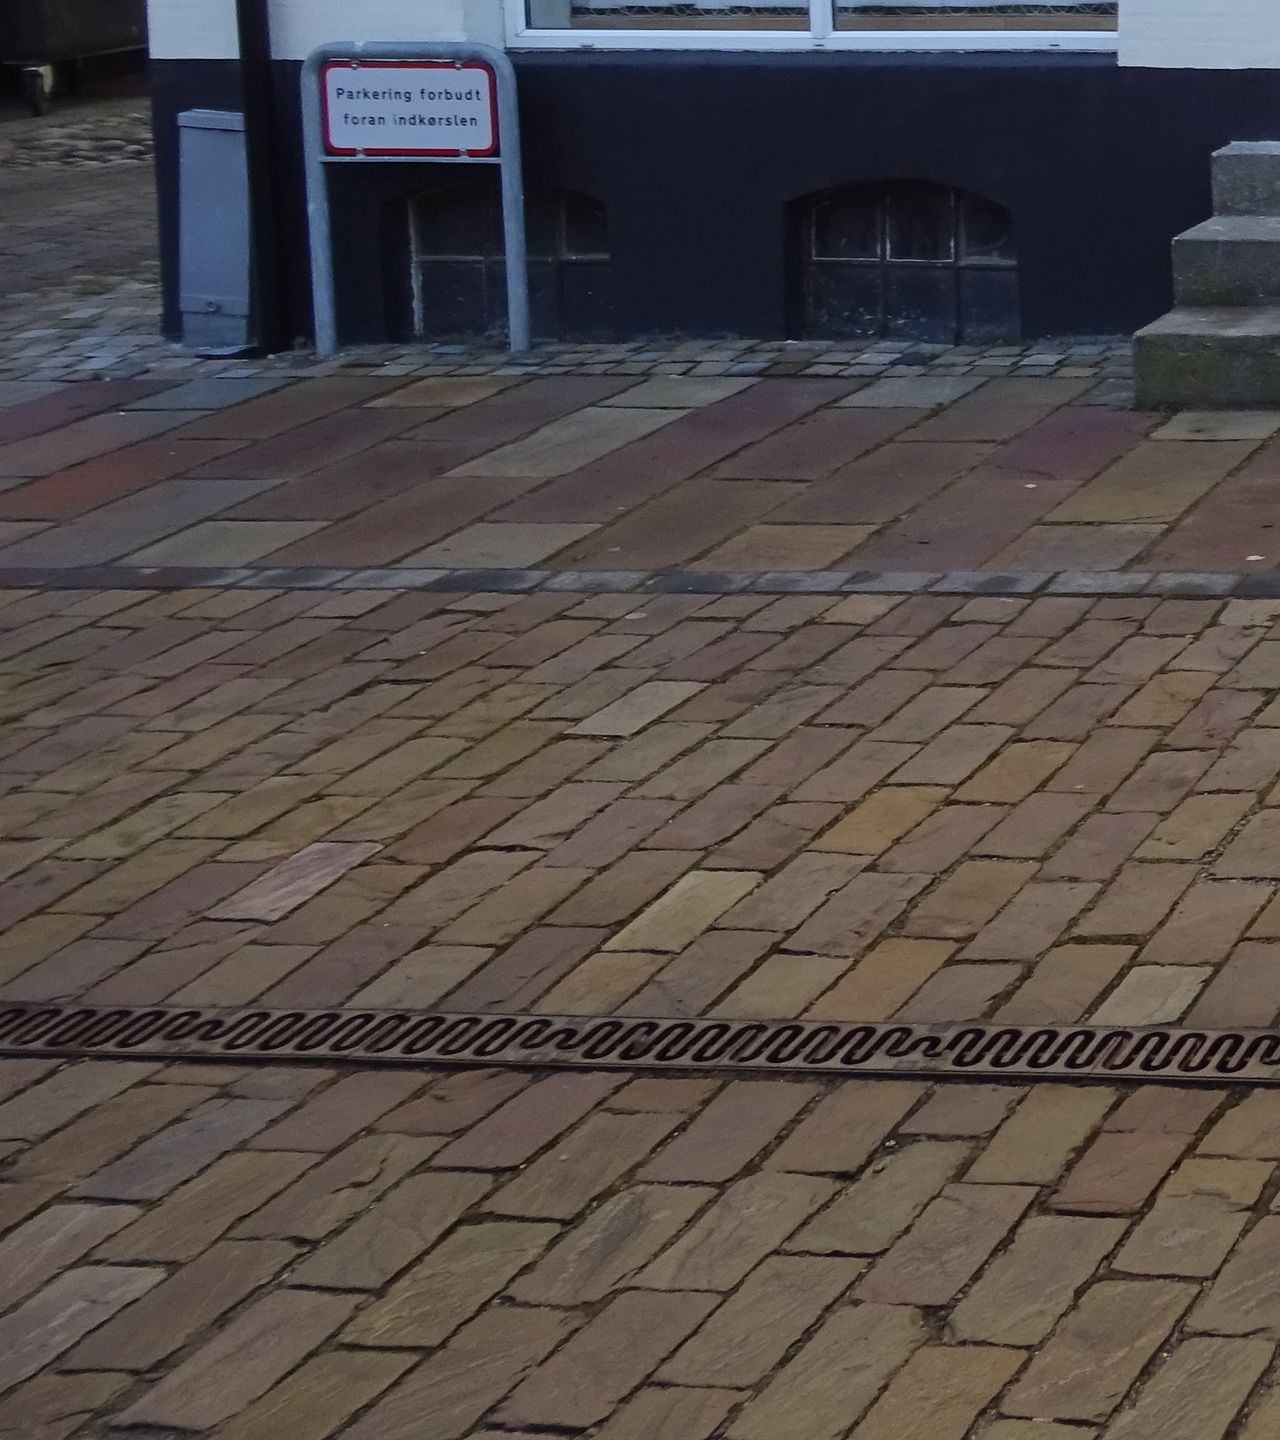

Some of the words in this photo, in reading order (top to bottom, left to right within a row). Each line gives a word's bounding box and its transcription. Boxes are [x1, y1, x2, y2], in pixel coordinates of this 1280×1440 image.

[336, 88, 412, 102] Parkering
[420, 88, 481, 101] forbudt
[344, 113, 386, 125] foran
[393, 114, 478, 127] indkørslen
